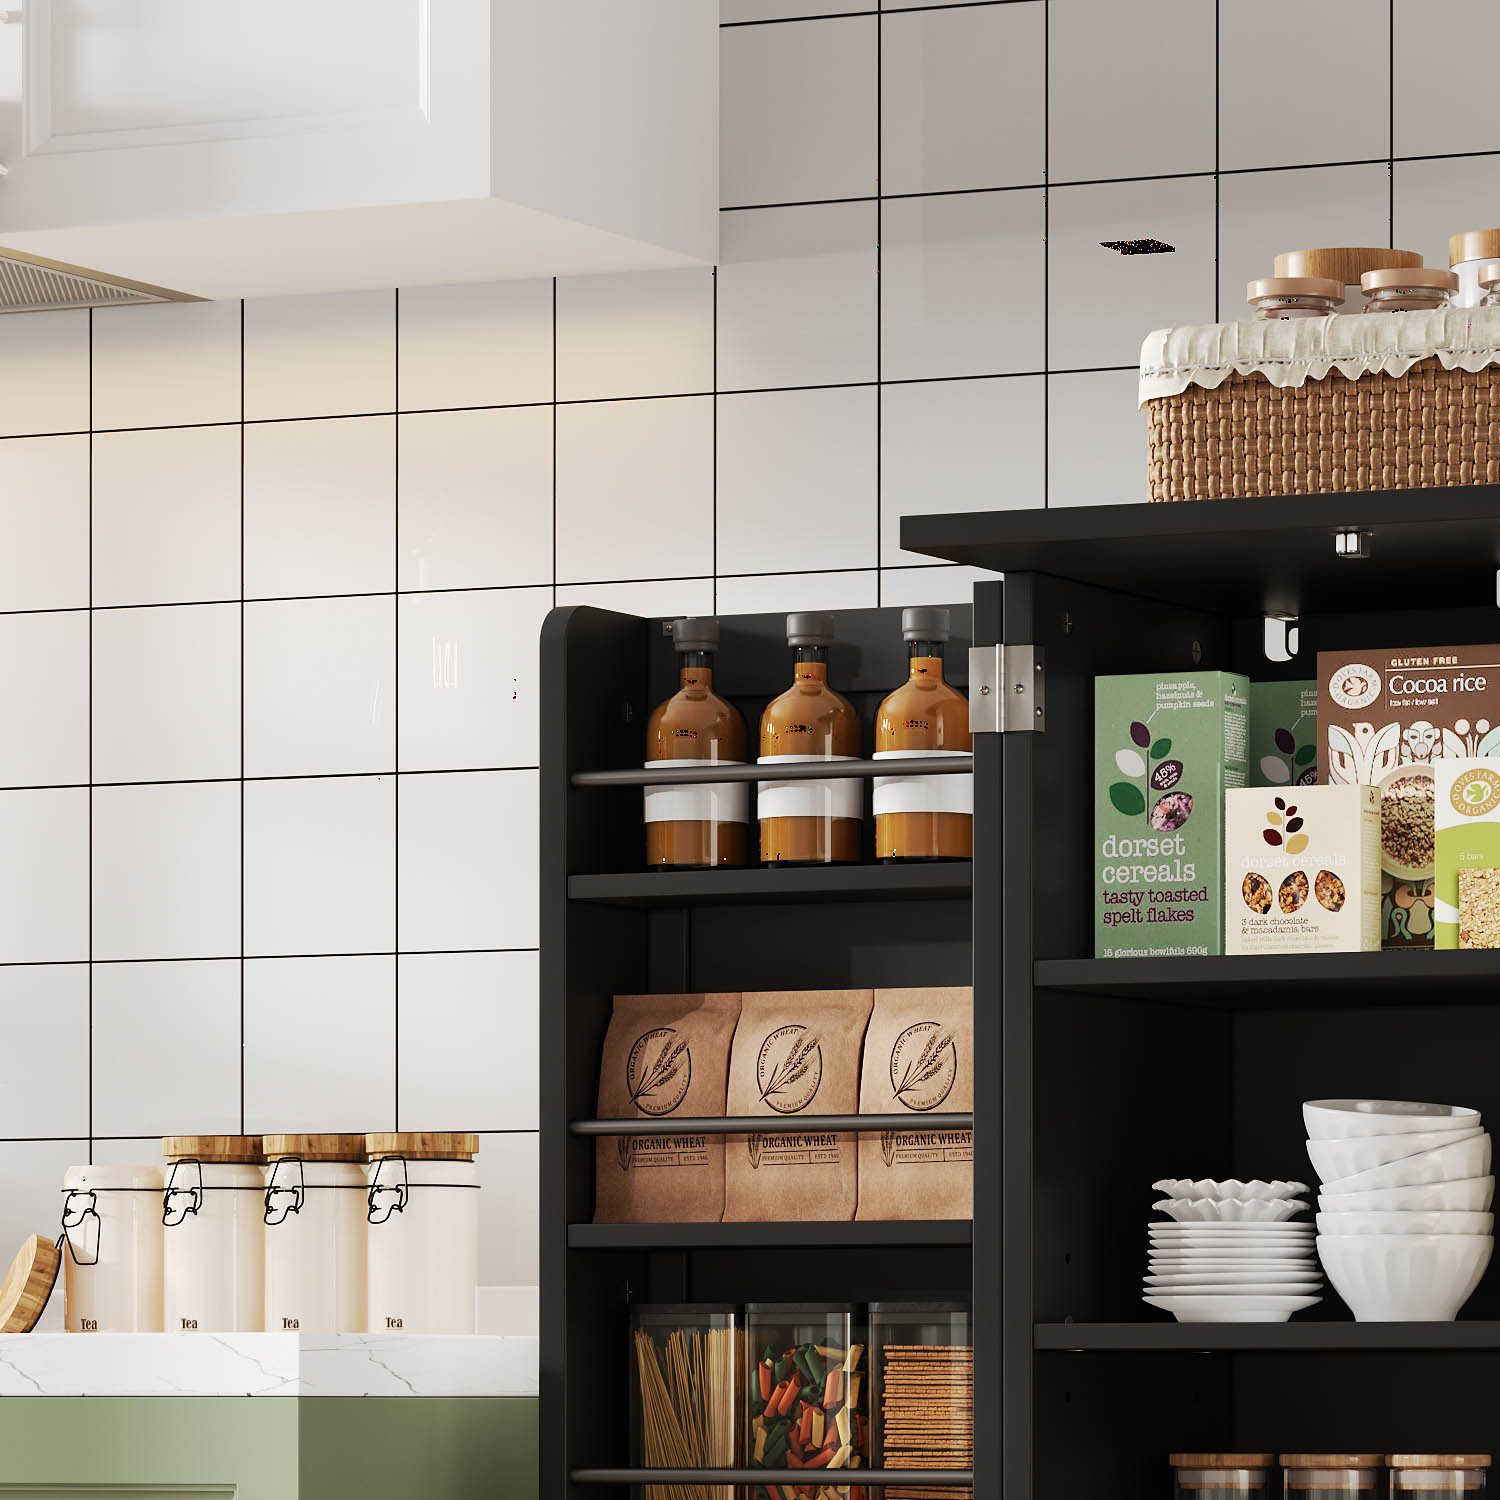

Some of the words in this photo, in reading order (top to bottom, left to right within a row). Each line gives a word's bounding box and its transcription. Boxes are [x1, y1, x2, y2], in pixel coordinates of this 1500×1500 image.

[1391, 657, 1429, 667] GLUTEN
[1433, 656, 1457, 665] FREE
[1389, 675, 1448, 695] Cocoa
[1453, 673, 1486, 692] rice
[1103, 834, 1185, 857] dorset
[1103, 859, 1195, 883] cereals
[1103, 889, 1144, 905] tasty
[1148, 887, 1208, 902] toasted
[1104, 909, 1143, 926] spelt
[1148, 908, 1193, 922] flakes
[1250, 917, 1267, 925] dark
[1270, 917, 1308, 925] chocolate
[1242, 926, 1248, 934] &
[1302, 925, 1318, 933] bars
[632, 1136, 672, 1150] ORGANIC
[674, 1135, 705, 1149] WHEAT
[762, 1135, 803, 1148] ORGANIC
[804, 1134, 837, 1147] WHEAT
[896, 1133, 936, 1147] ORGANIC
[938, 1132, 971, 1145] WHEAT
[80, 1318, 98, 1330] Tea
[181, 1318, 198, 1329] Tea
[282, 1318, 299, 1329] Tea
[386, 1317, 402, 1329] Tea
